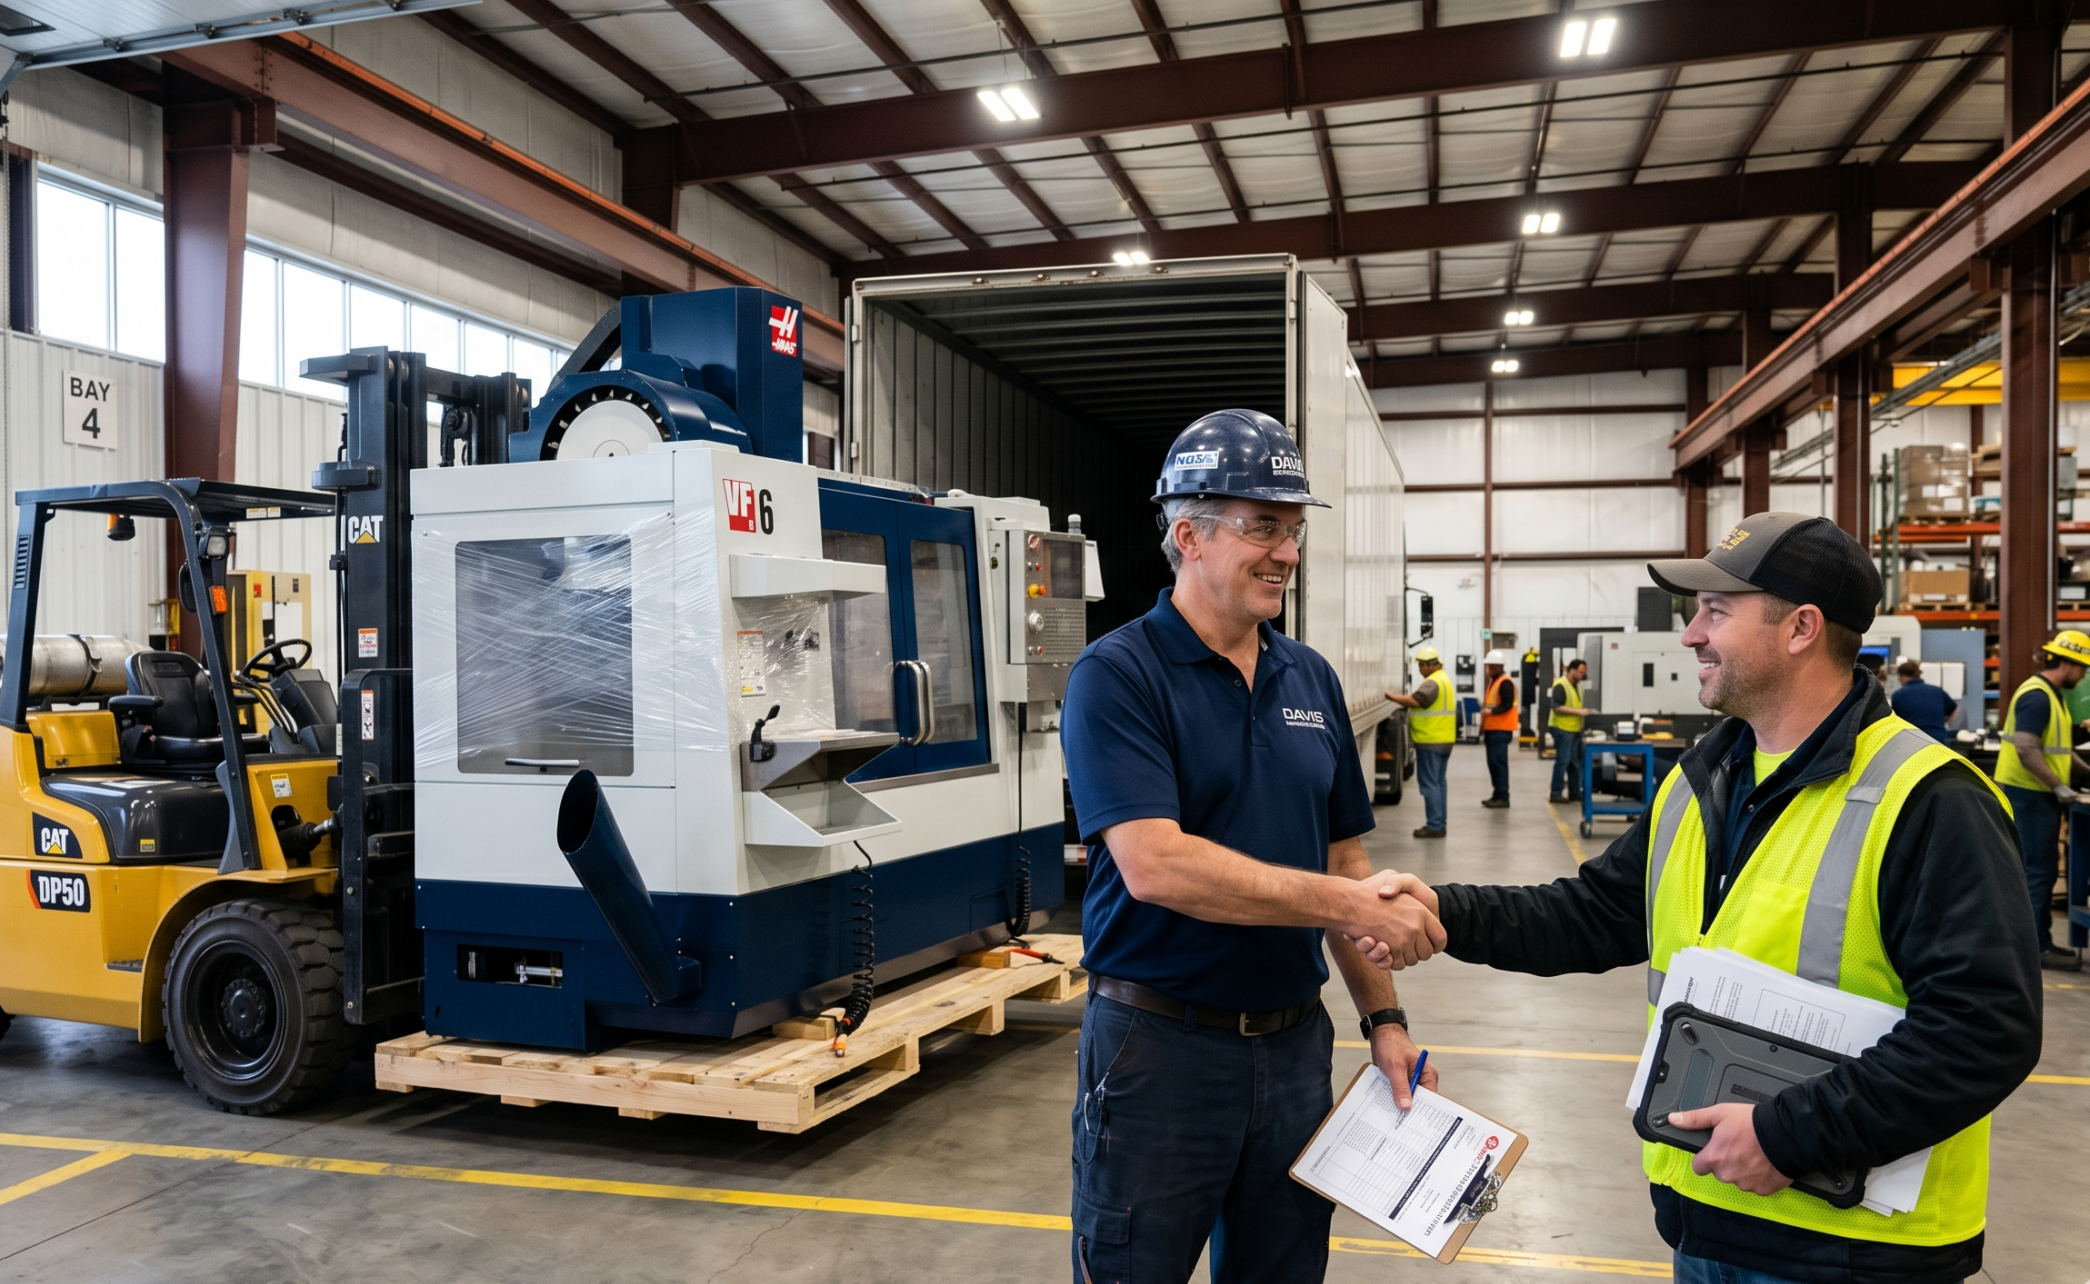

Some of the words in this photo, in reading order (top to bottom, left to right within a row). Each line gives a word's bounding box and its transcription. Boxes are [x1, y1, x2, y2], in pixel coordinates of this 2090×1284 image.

[70, 376, 111, 402] BAY
[82, 407, 101, 439] 4
[722, 478, 753, 518] VF
[758, 488, 775, 535] 6
[348, 515, 384, 544] CAT
[1282, 707, 1325, 723] DAVIS
[41, 827, 69, 854] CAT
[38, 875, 85, 906] DP50
